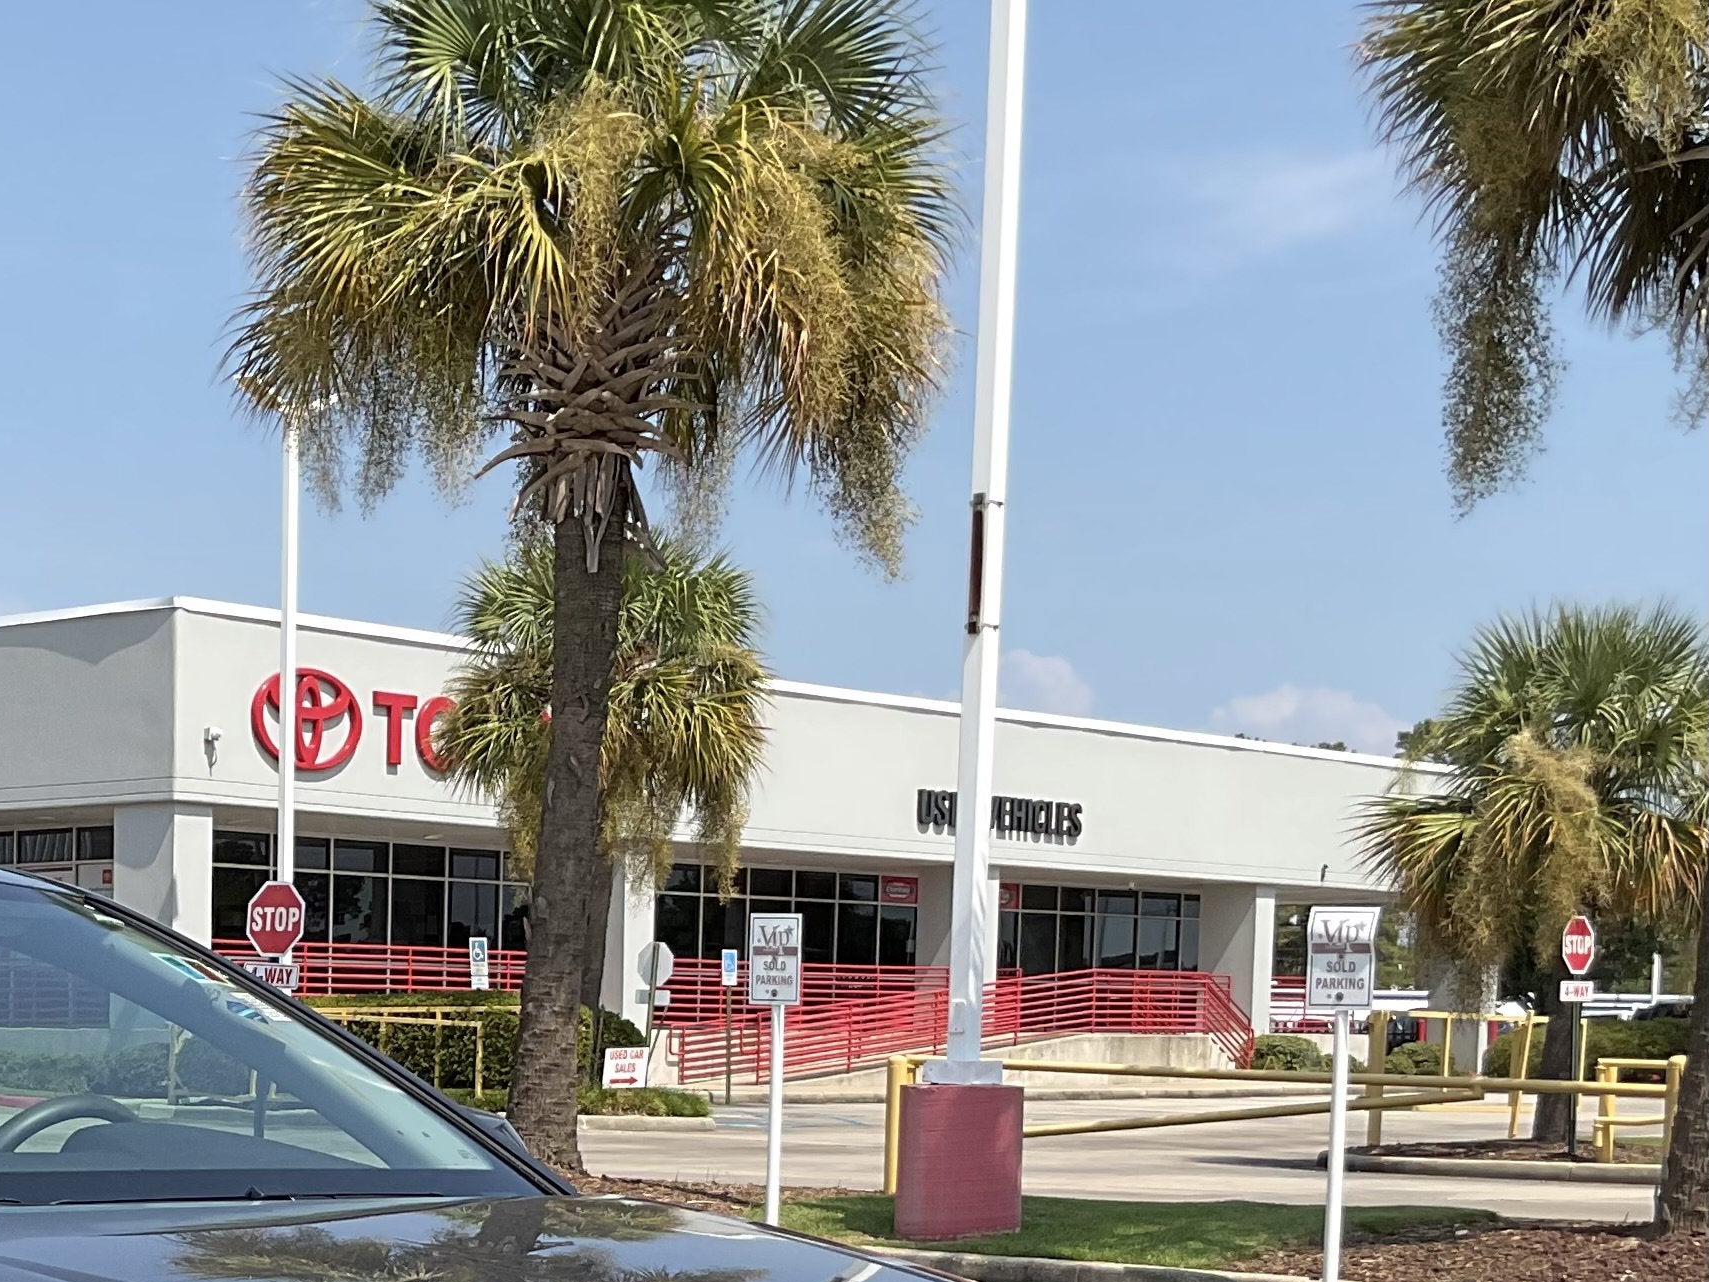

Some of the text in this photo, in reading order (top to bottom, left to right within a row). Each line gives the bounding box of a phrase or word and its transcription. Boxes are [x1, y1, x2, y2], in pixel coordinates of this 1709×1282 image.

[917, 788, 957, 828] US
[252, 906, 300, 932] STOP
[1565, 934, 1591, 955] STOP
[763, 960, 787, 971] SOLD
[1326, 960, 1357, 973] SOLD
[755, 974, 794, 986] PARKING
[1315, 977, 1365, 990] PARKING
[1564, 985, 1590, 998] 4-WAY
[609, 1049, 645, 1060] USED CAR
[614, 1062, 637, 1073] SALES
